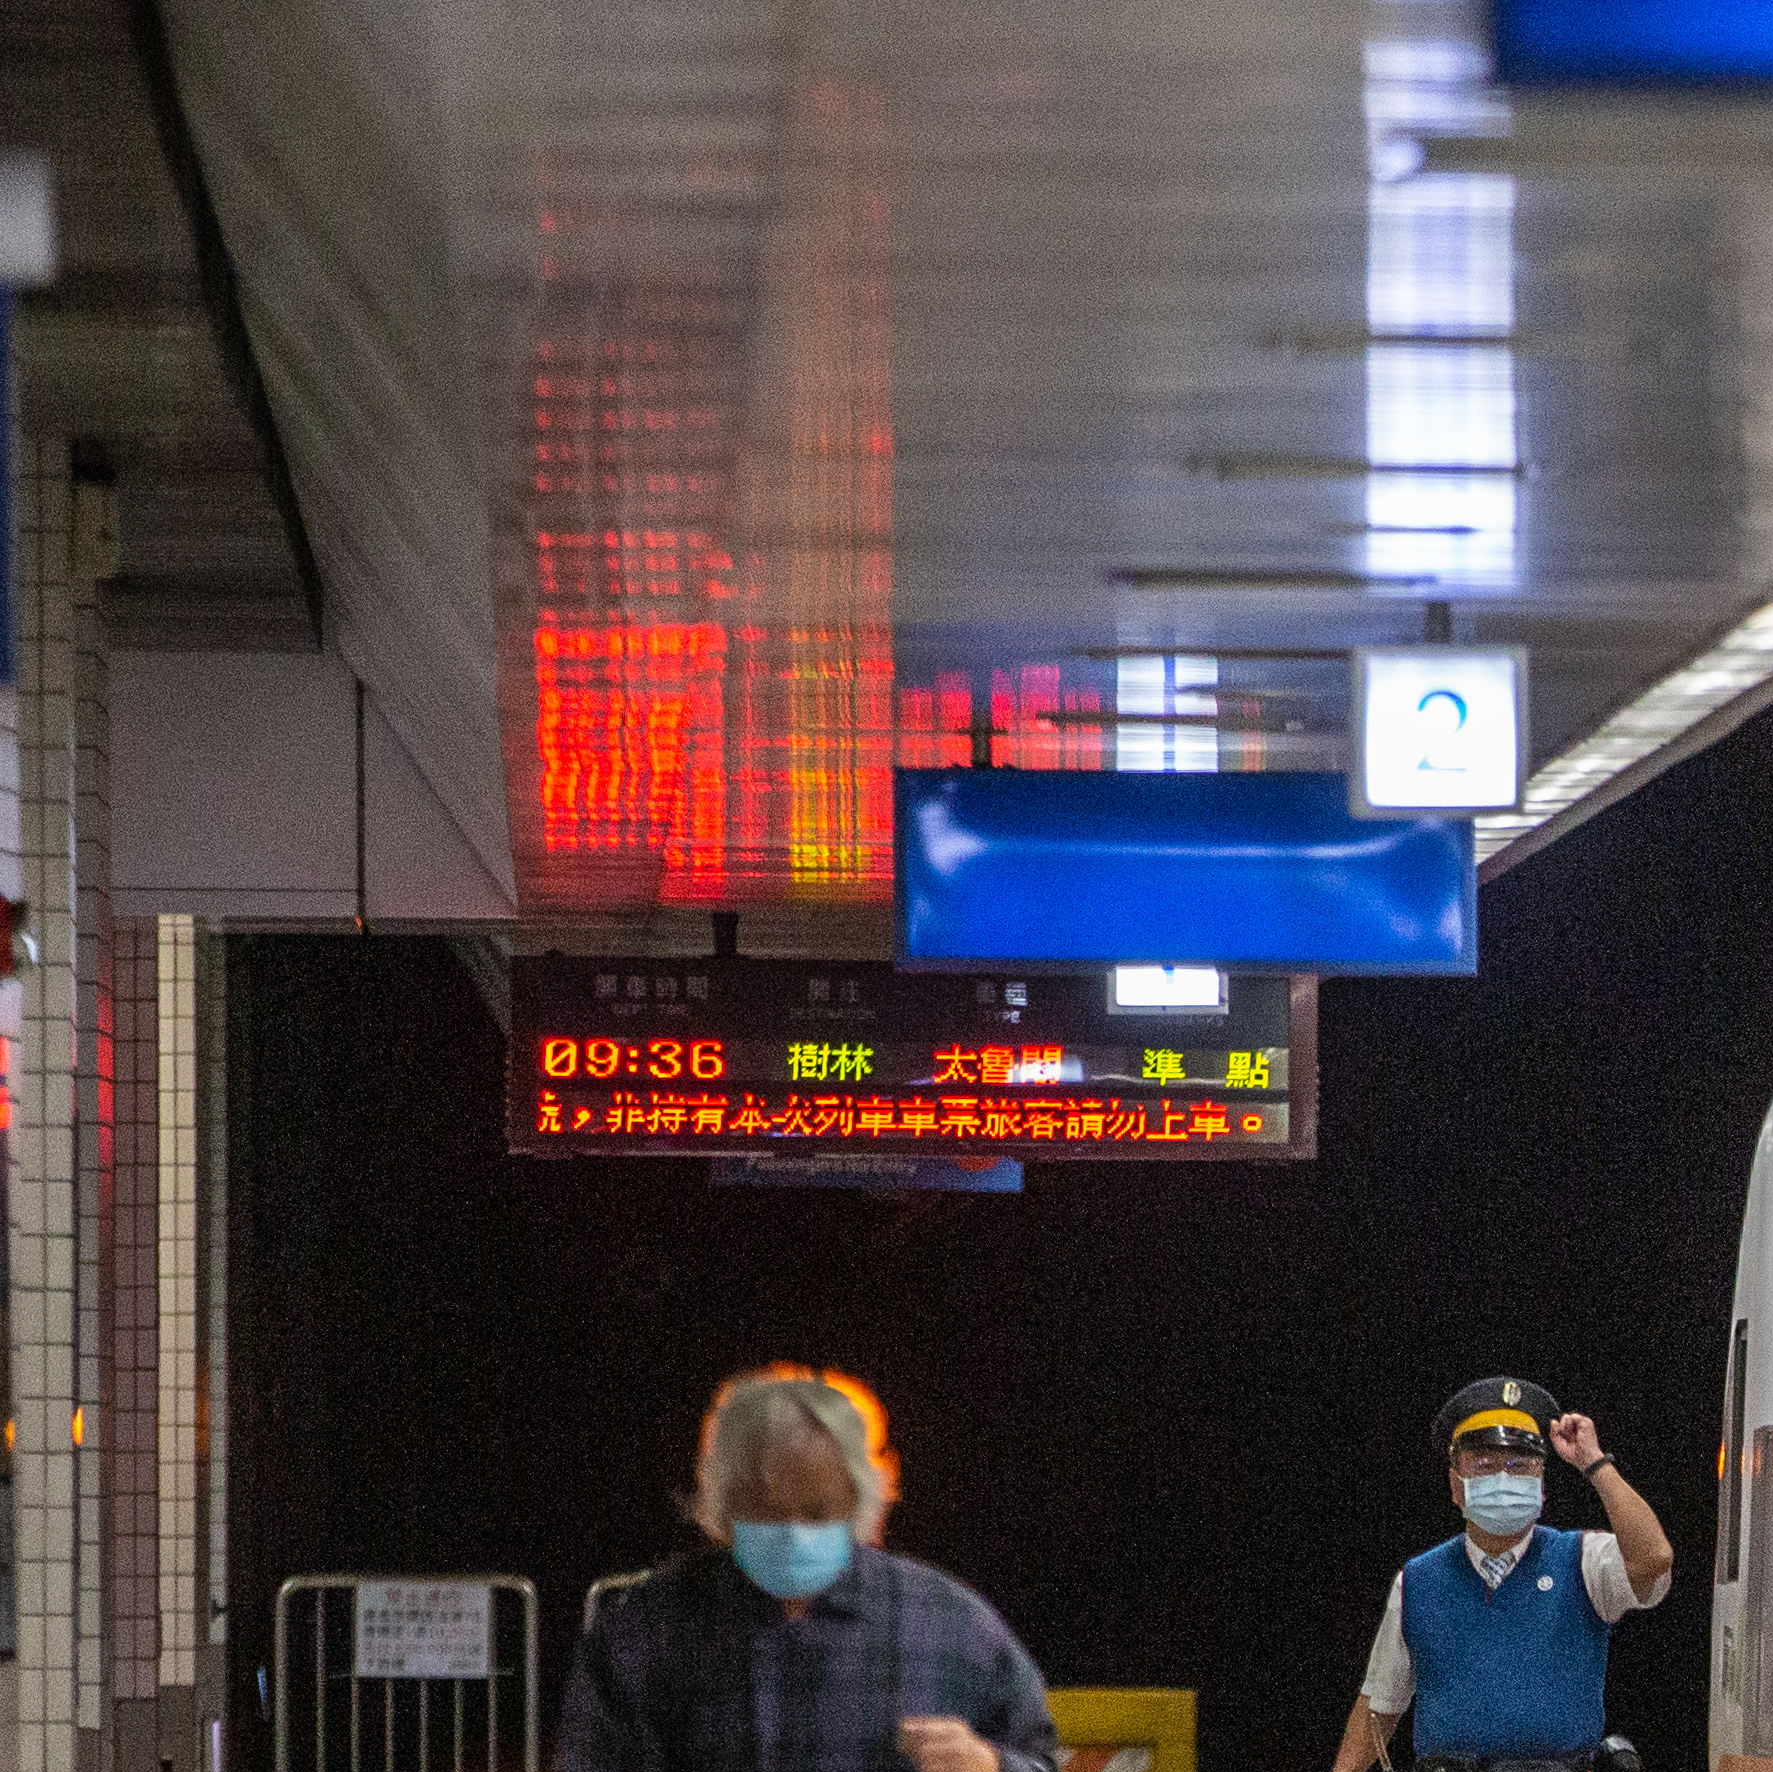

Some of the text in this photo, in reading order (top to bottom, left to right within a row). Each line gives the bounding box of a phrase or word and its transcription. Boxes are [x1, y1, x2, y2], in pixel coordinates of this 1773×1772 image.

[1416, 687, 1469, 772] 2
[541, 1037, 726, 1081] 09:36
[787, 1042, 874, 1082] 樹林
